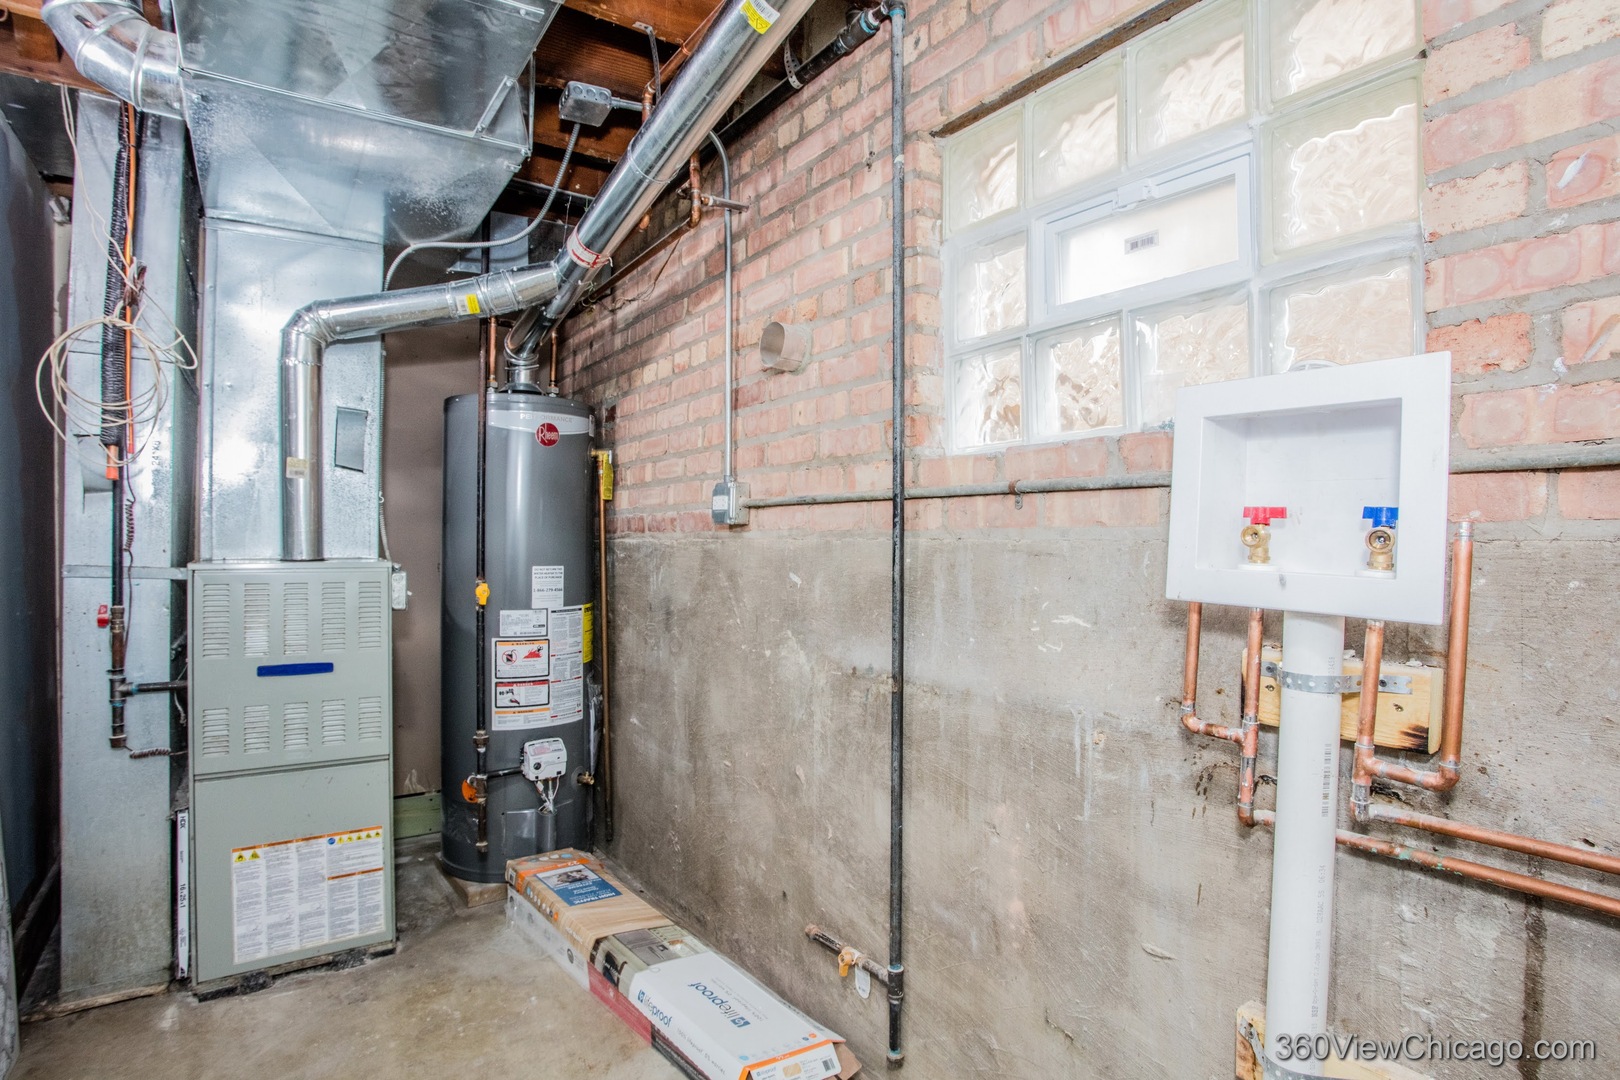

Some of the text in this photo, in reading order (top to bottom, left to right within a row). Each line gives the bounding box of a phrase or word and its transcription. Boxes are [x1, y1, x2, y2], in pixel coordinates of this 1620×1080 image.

[538, 422, 559, 444] Rheem
[644, 994, 673, 1027] lifeproof
[688, 982, 740, 1019] lifeproof
